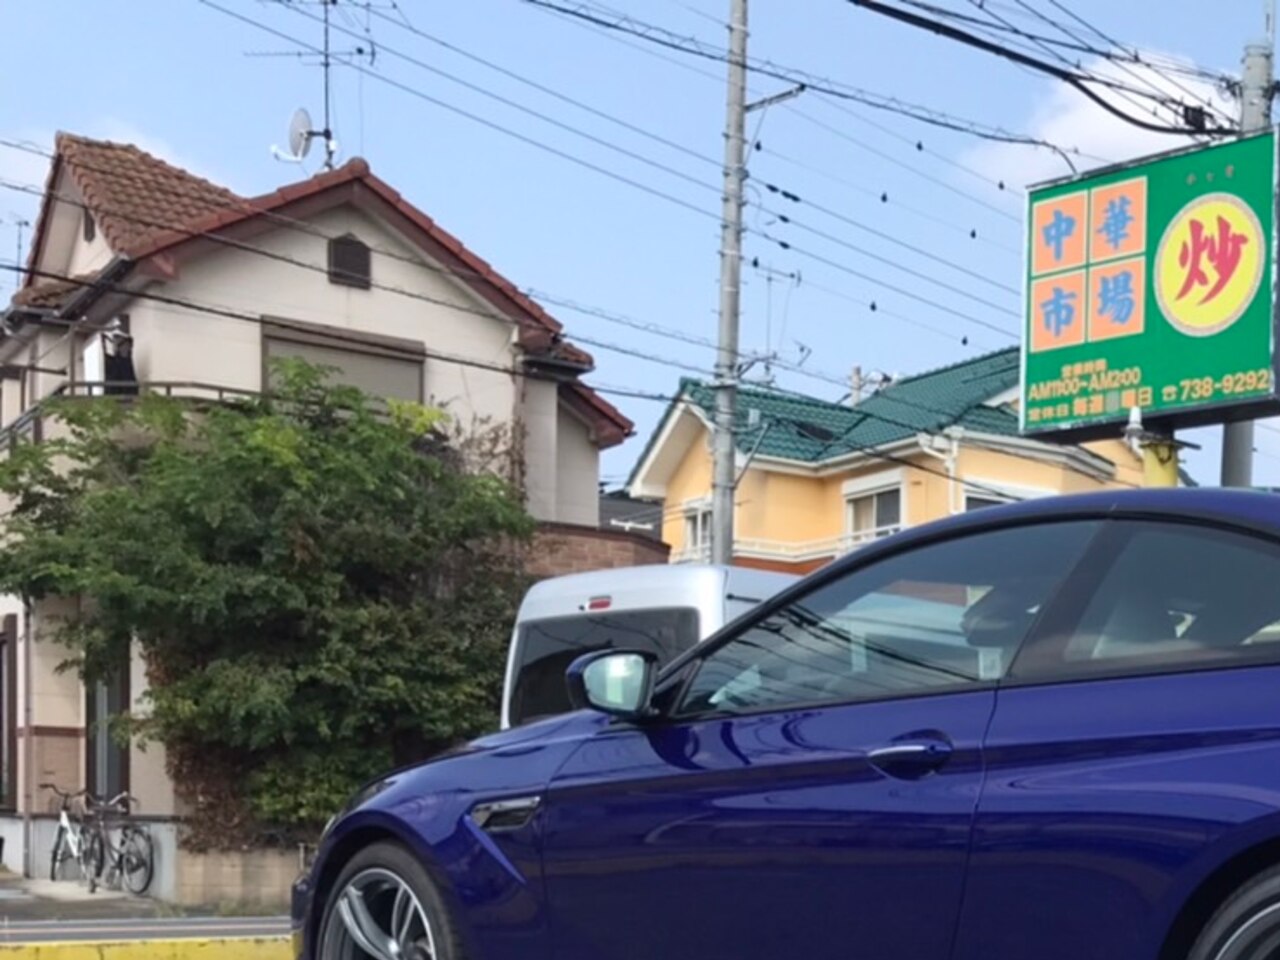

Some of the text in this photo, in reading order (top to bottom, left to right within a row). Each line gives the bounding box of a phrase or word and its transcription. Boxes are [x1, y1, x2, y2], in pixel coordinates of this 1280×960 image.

[1042, 195, 1135, 261] 中華
[1175, 214, 1249, 306] 炒
[1040, 270, 1135, 338] 市場
[1179, 368, 1269, 401] 738-9292
